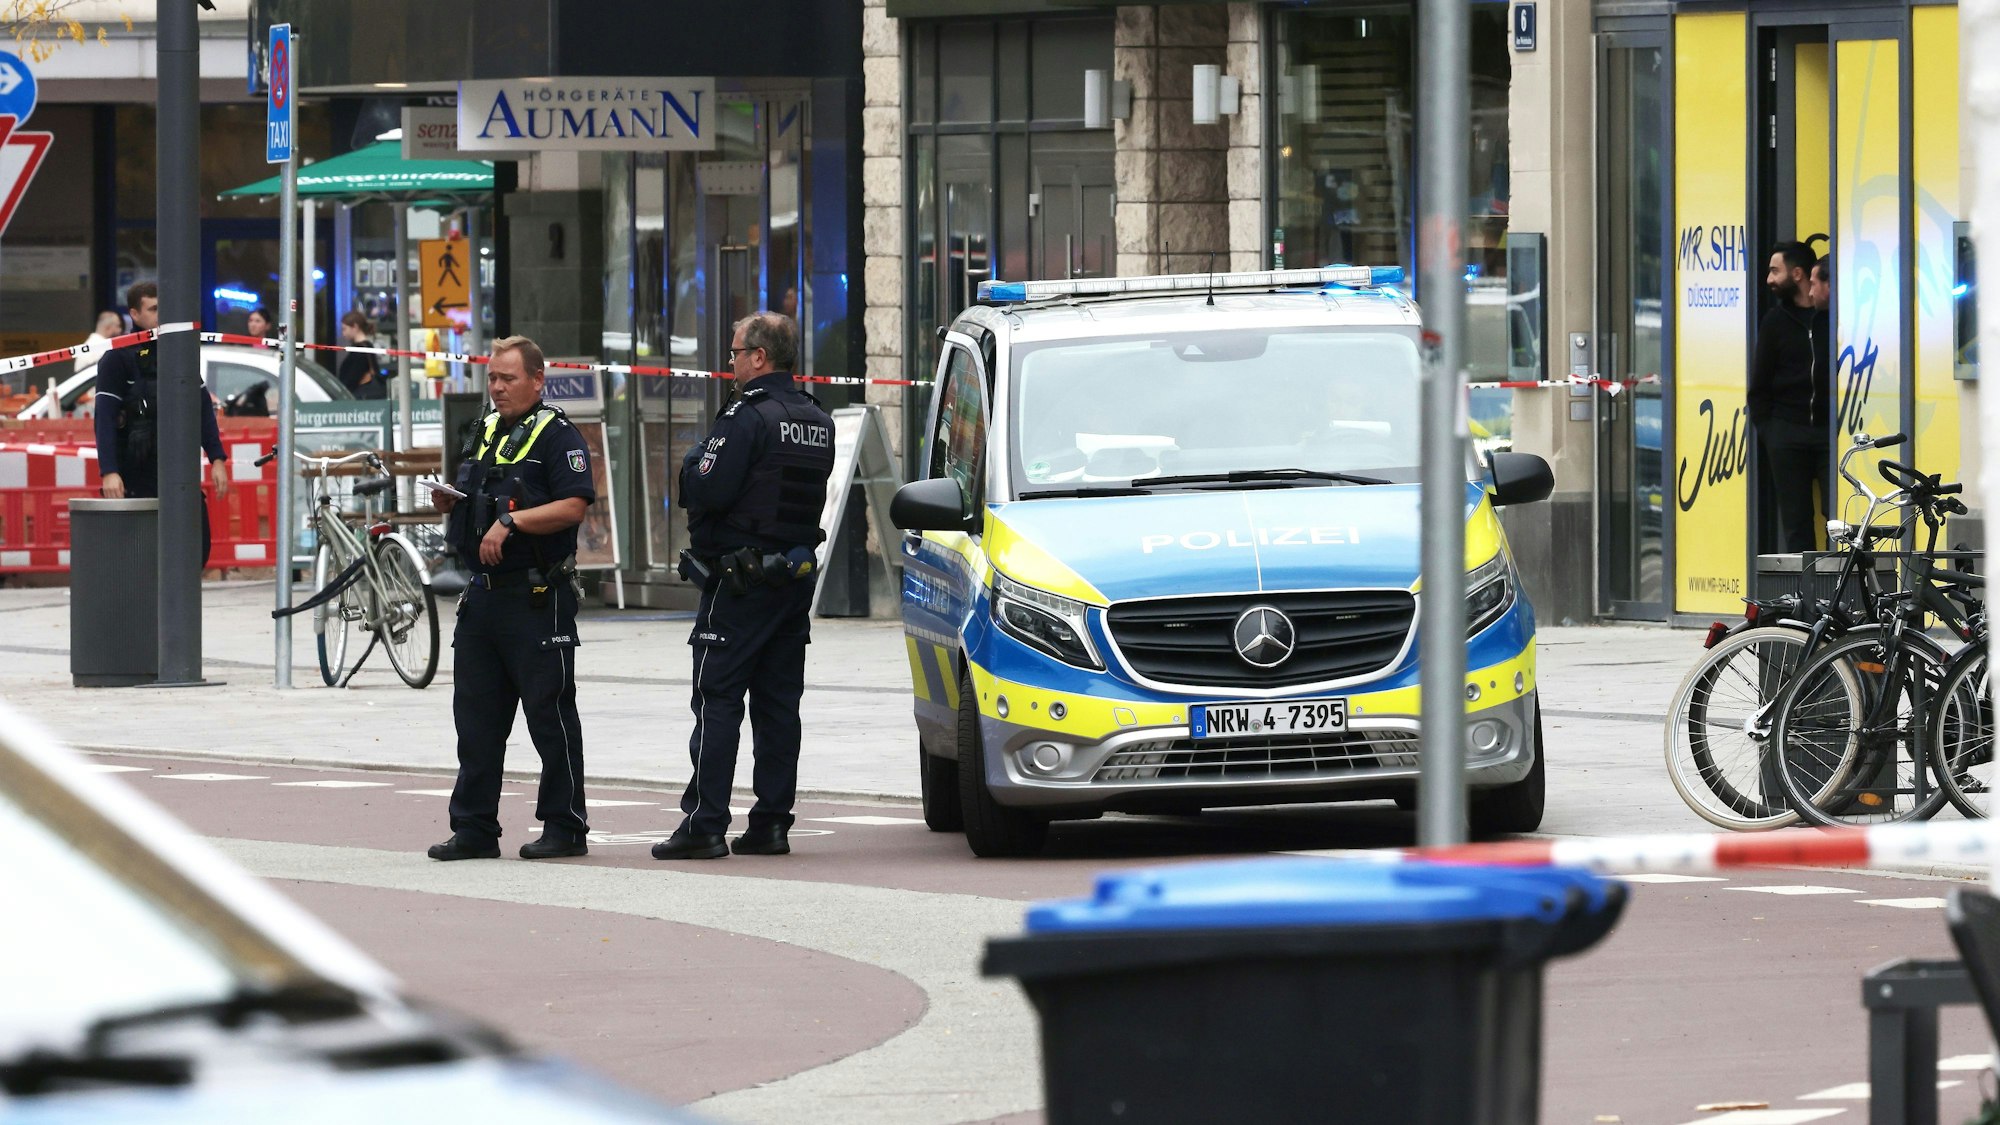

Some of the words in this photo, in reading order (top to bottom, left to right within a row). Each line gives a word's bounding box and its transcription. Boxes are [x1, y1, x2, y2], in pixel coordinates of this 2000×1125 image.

[1521, 9, 1527, 32] 6
[524, 88, 649, 101] HÖRGERÄTE
[477, 89, 705, 139] AUMANN
[269, 121, 288, 148] TAXI
[1688, 283, 1740, 308] DÜSSELDORF
[541, 378, 585, 396] MANN
[779, 421, 829, 448] POLIZEI
[1141, 526, 1360, 554] POLIZEI
[1688, 577, 1740, 594] WWW.MR-SHA.DE
[552, 635, 570, 643] POLIZEI
[1196, 725, 1203, 733] D
[1206, 709, 1249, 733] NRW
[1263, 703, 1344, 731] 4-7395
